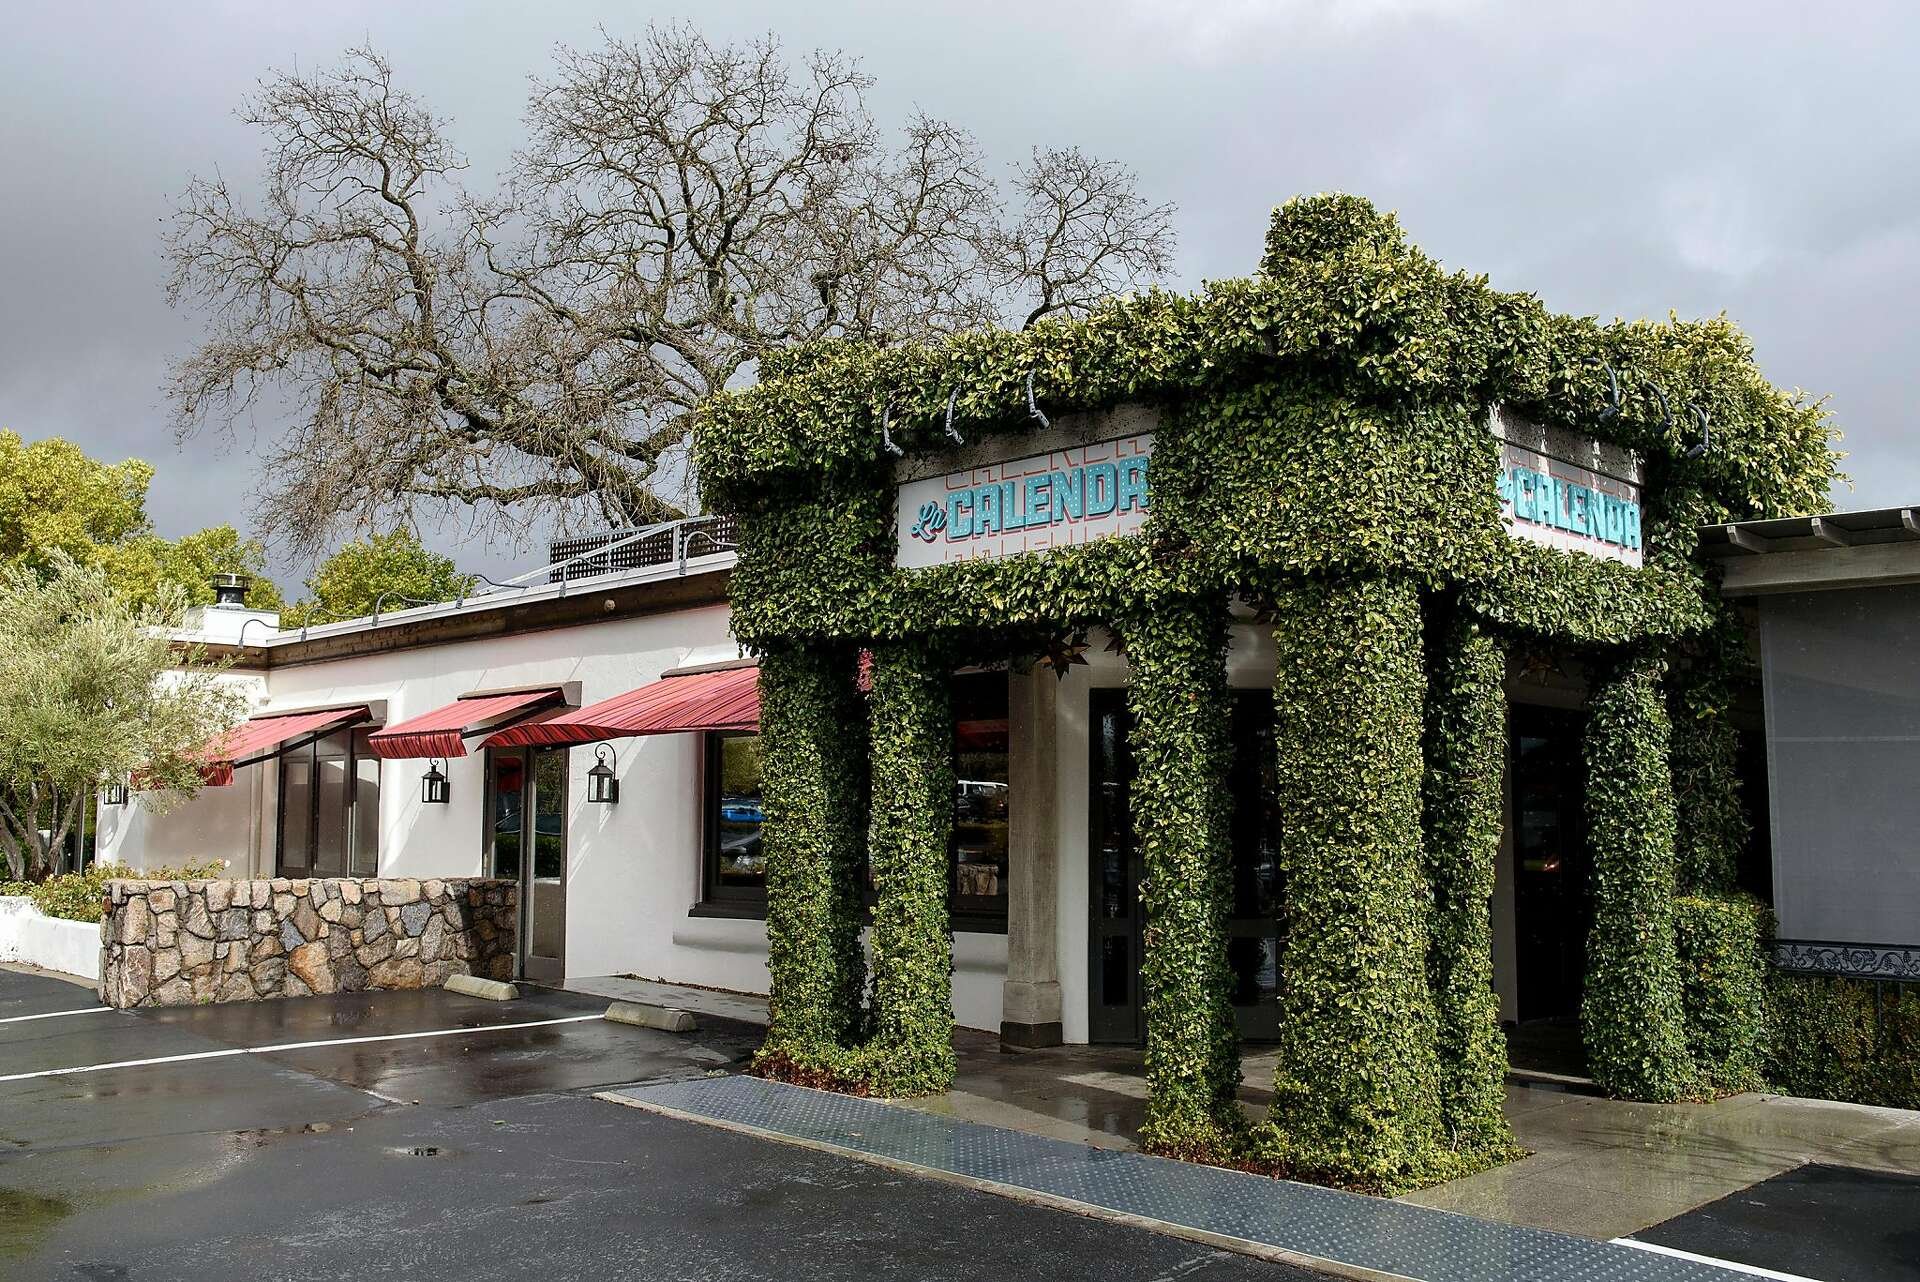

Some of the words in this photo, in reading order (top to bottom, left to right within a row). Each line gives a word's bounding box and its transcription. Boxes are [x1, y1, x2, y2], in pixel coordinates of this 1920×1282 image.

[911, 500, 947, 543] La
[946, 455, 1150, 541] CALENDA
[1513, 467, 1642, 551] CALENDA
